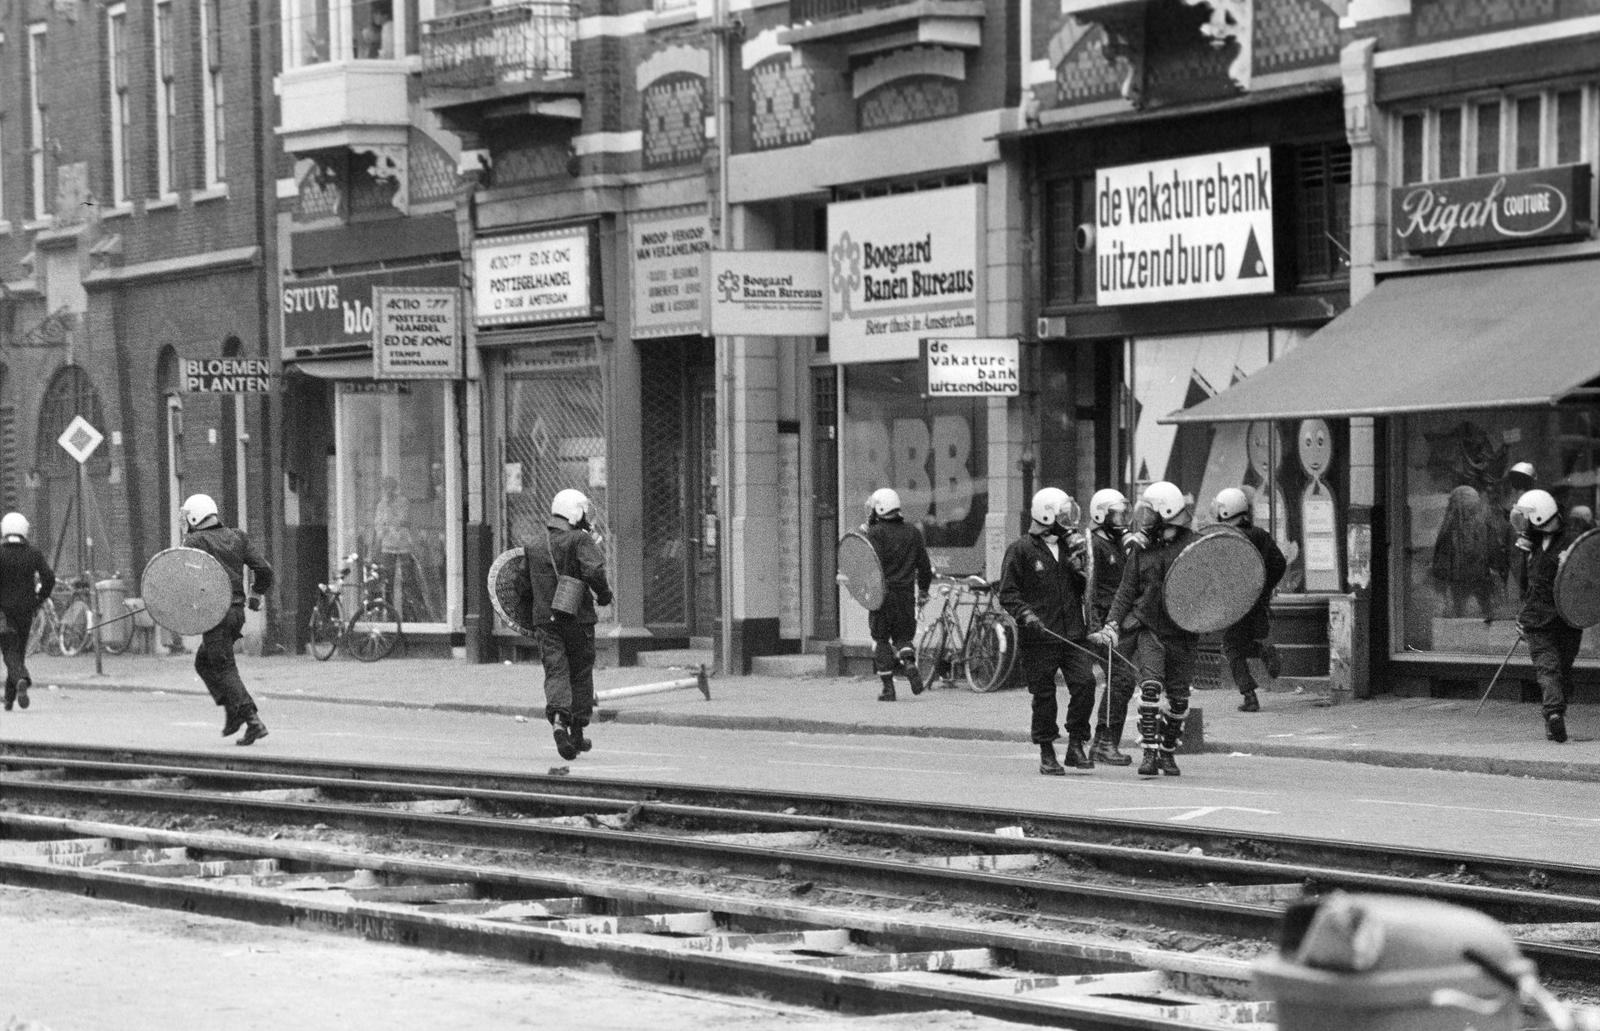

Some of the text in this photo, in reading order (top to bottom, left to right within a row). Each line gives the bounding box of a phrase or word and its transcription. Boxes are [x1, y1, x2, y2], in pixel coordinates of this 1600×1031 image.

[1100, 157, 1270, 228] de vakaturebank
[1397, 177, 1550, 247] Rigah COUTURE
[863, 233, 932, 273] Boogaard
[1100, 233, 1225, 291] uitzendburo
[743, 274, 793, 288] Boogaard
[863, 269, 974, 302] Banen Bureaus
[283, 285, 339, 313] STUVE
[743, 287, 822, 298] Banen Bureaus
[396, 324, 440, 332] HANDEL
[924, 311, 975, 330] Amsterdam
[384, 335, 452, 346] ED DE JONG
[930, 340, 949, 353] de
[187, 360, 269, 375] BLOEMEN
[977, 368, 1017, 379] bank
[188, 377, 269, 392] PLANTEN
[930, 380, 1017, 393] uitzendburo
